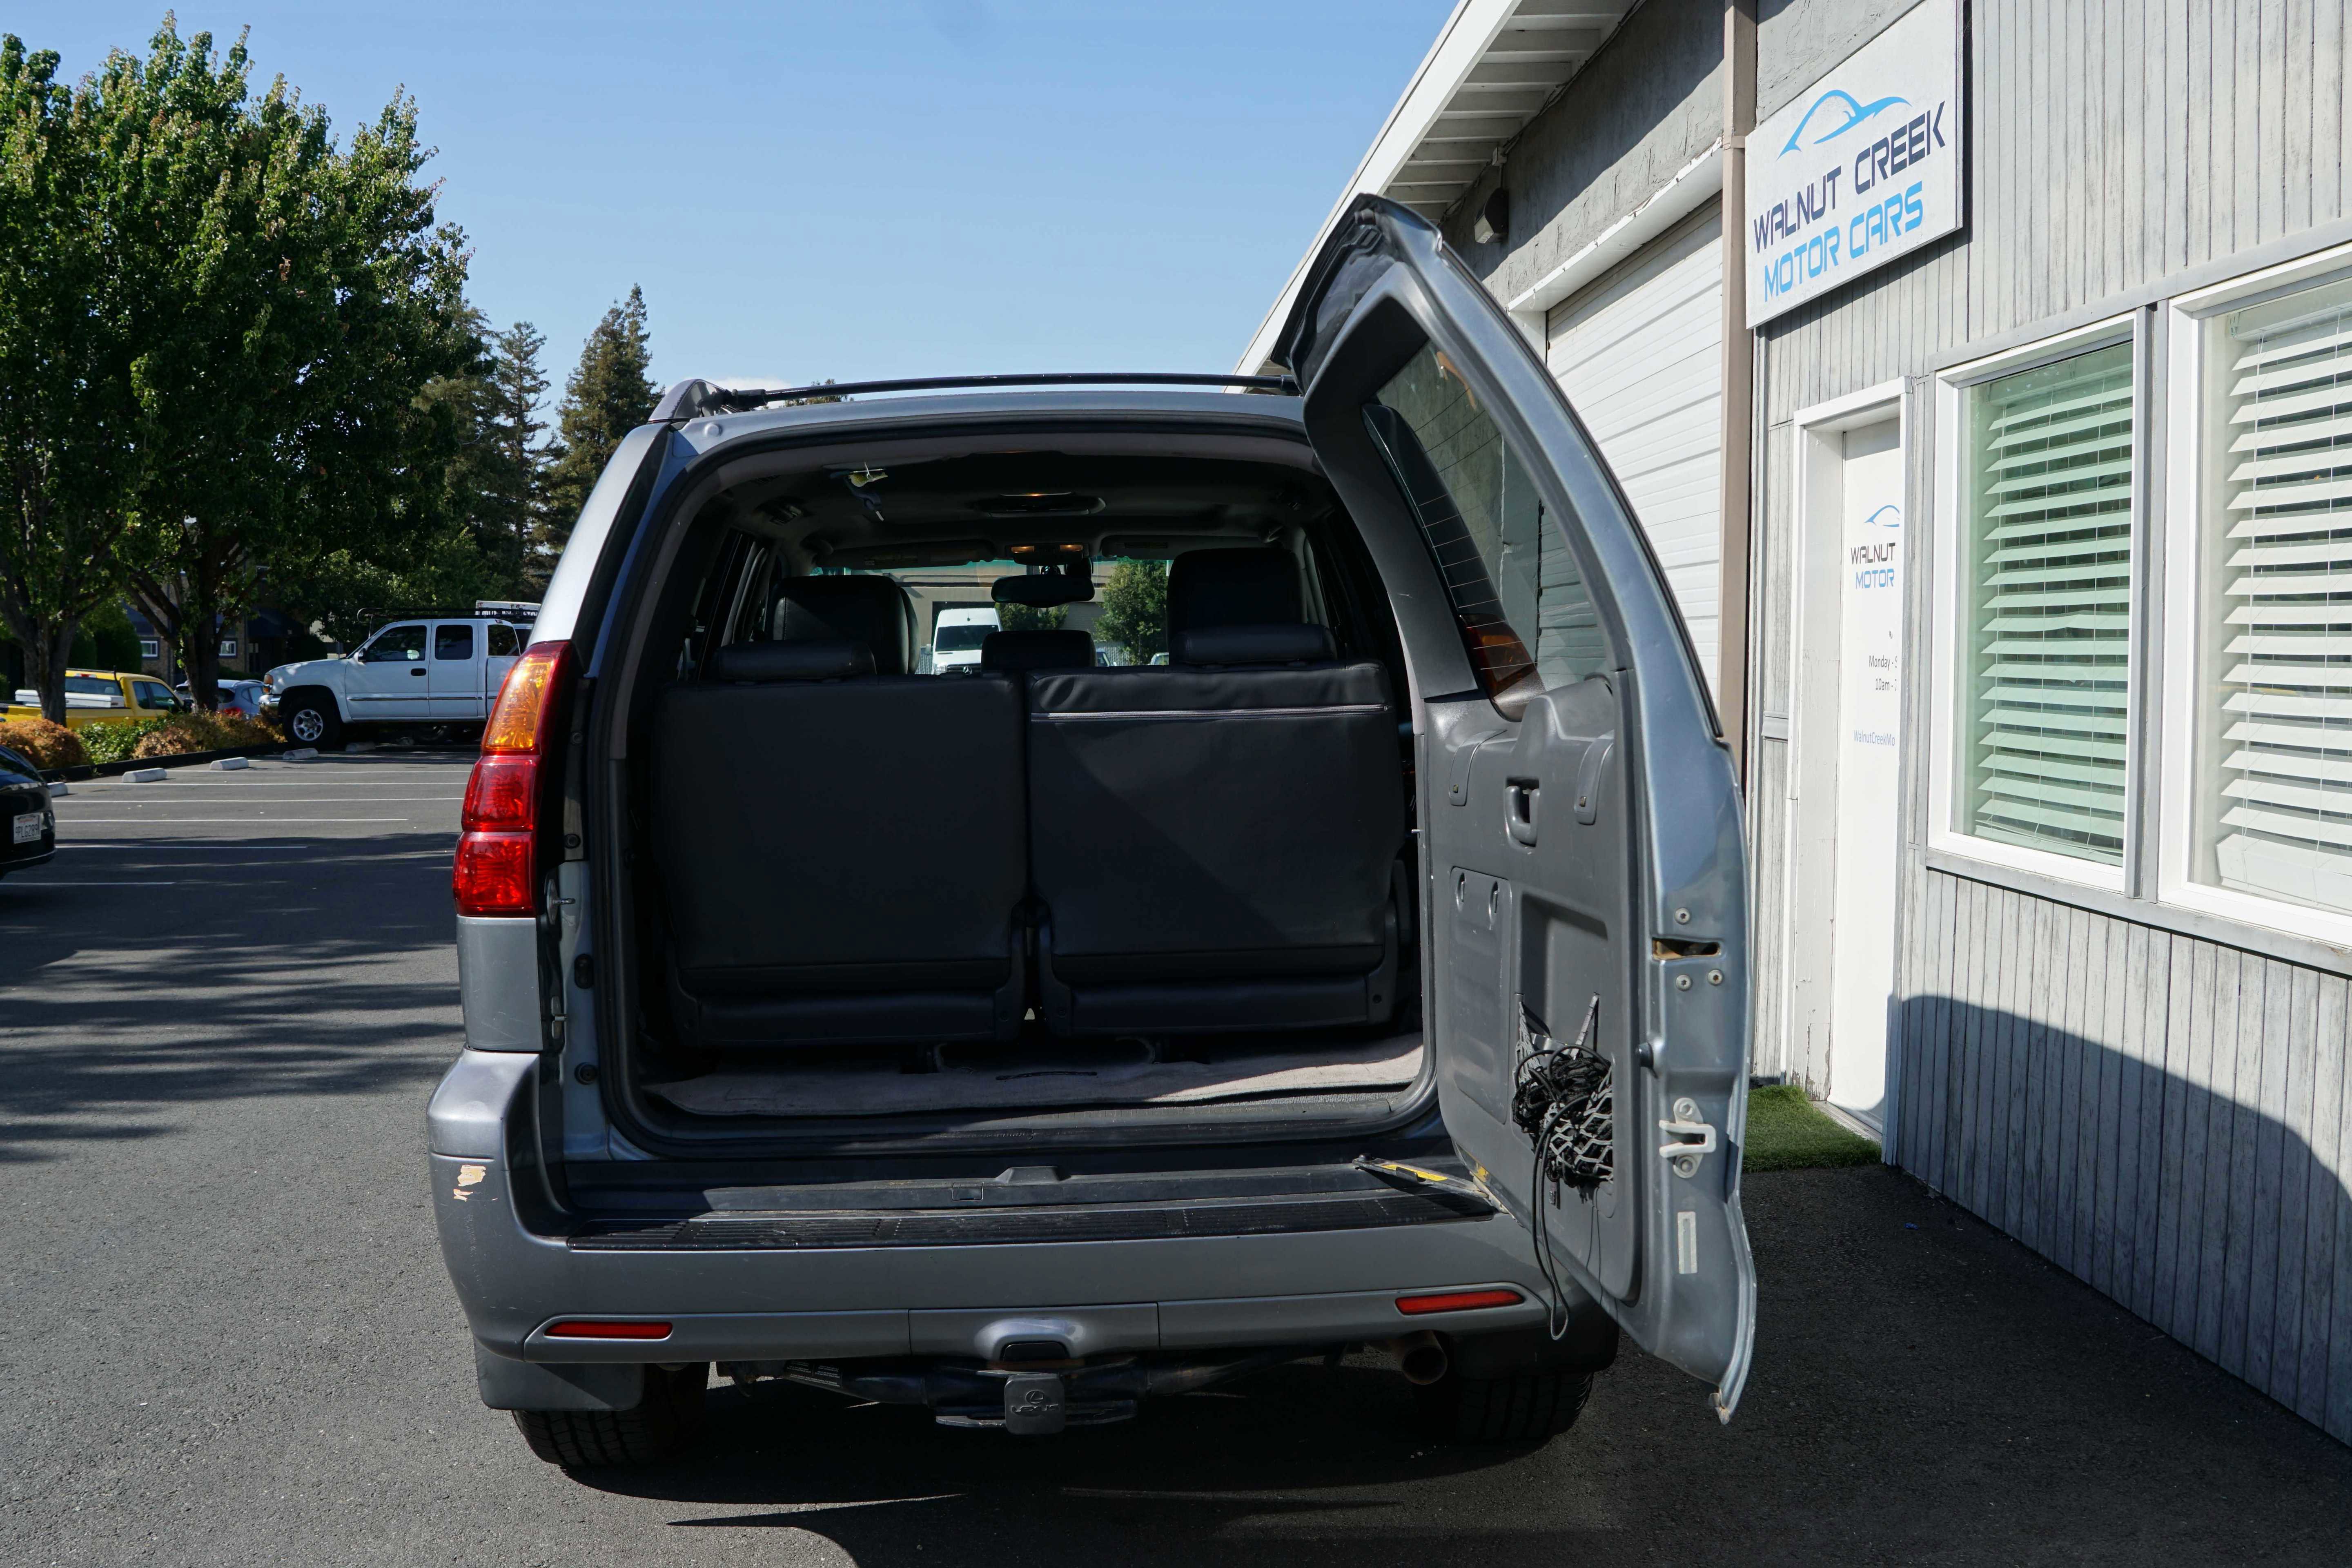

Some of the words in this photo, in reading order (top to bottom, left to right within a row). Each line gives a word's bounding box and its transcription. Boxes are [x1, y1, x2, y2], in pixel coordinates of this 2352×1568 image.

[1754, 165, 1841, 253] WALNUT
[1855, 100, 1946, 195] CREEK
[1764, 226, 1840, 302] MOTOR
[1849, 180, 1923, 259] CARS
[1850, 542, 1896, 565] WALNUT
[1855, 568, 1895, 590] MOTOR
[1869, 655, 1890, 671] Monday
[1875, 678, 1890, 690] 10am
[1011, 1404, 1060, 1413] LEXUS
